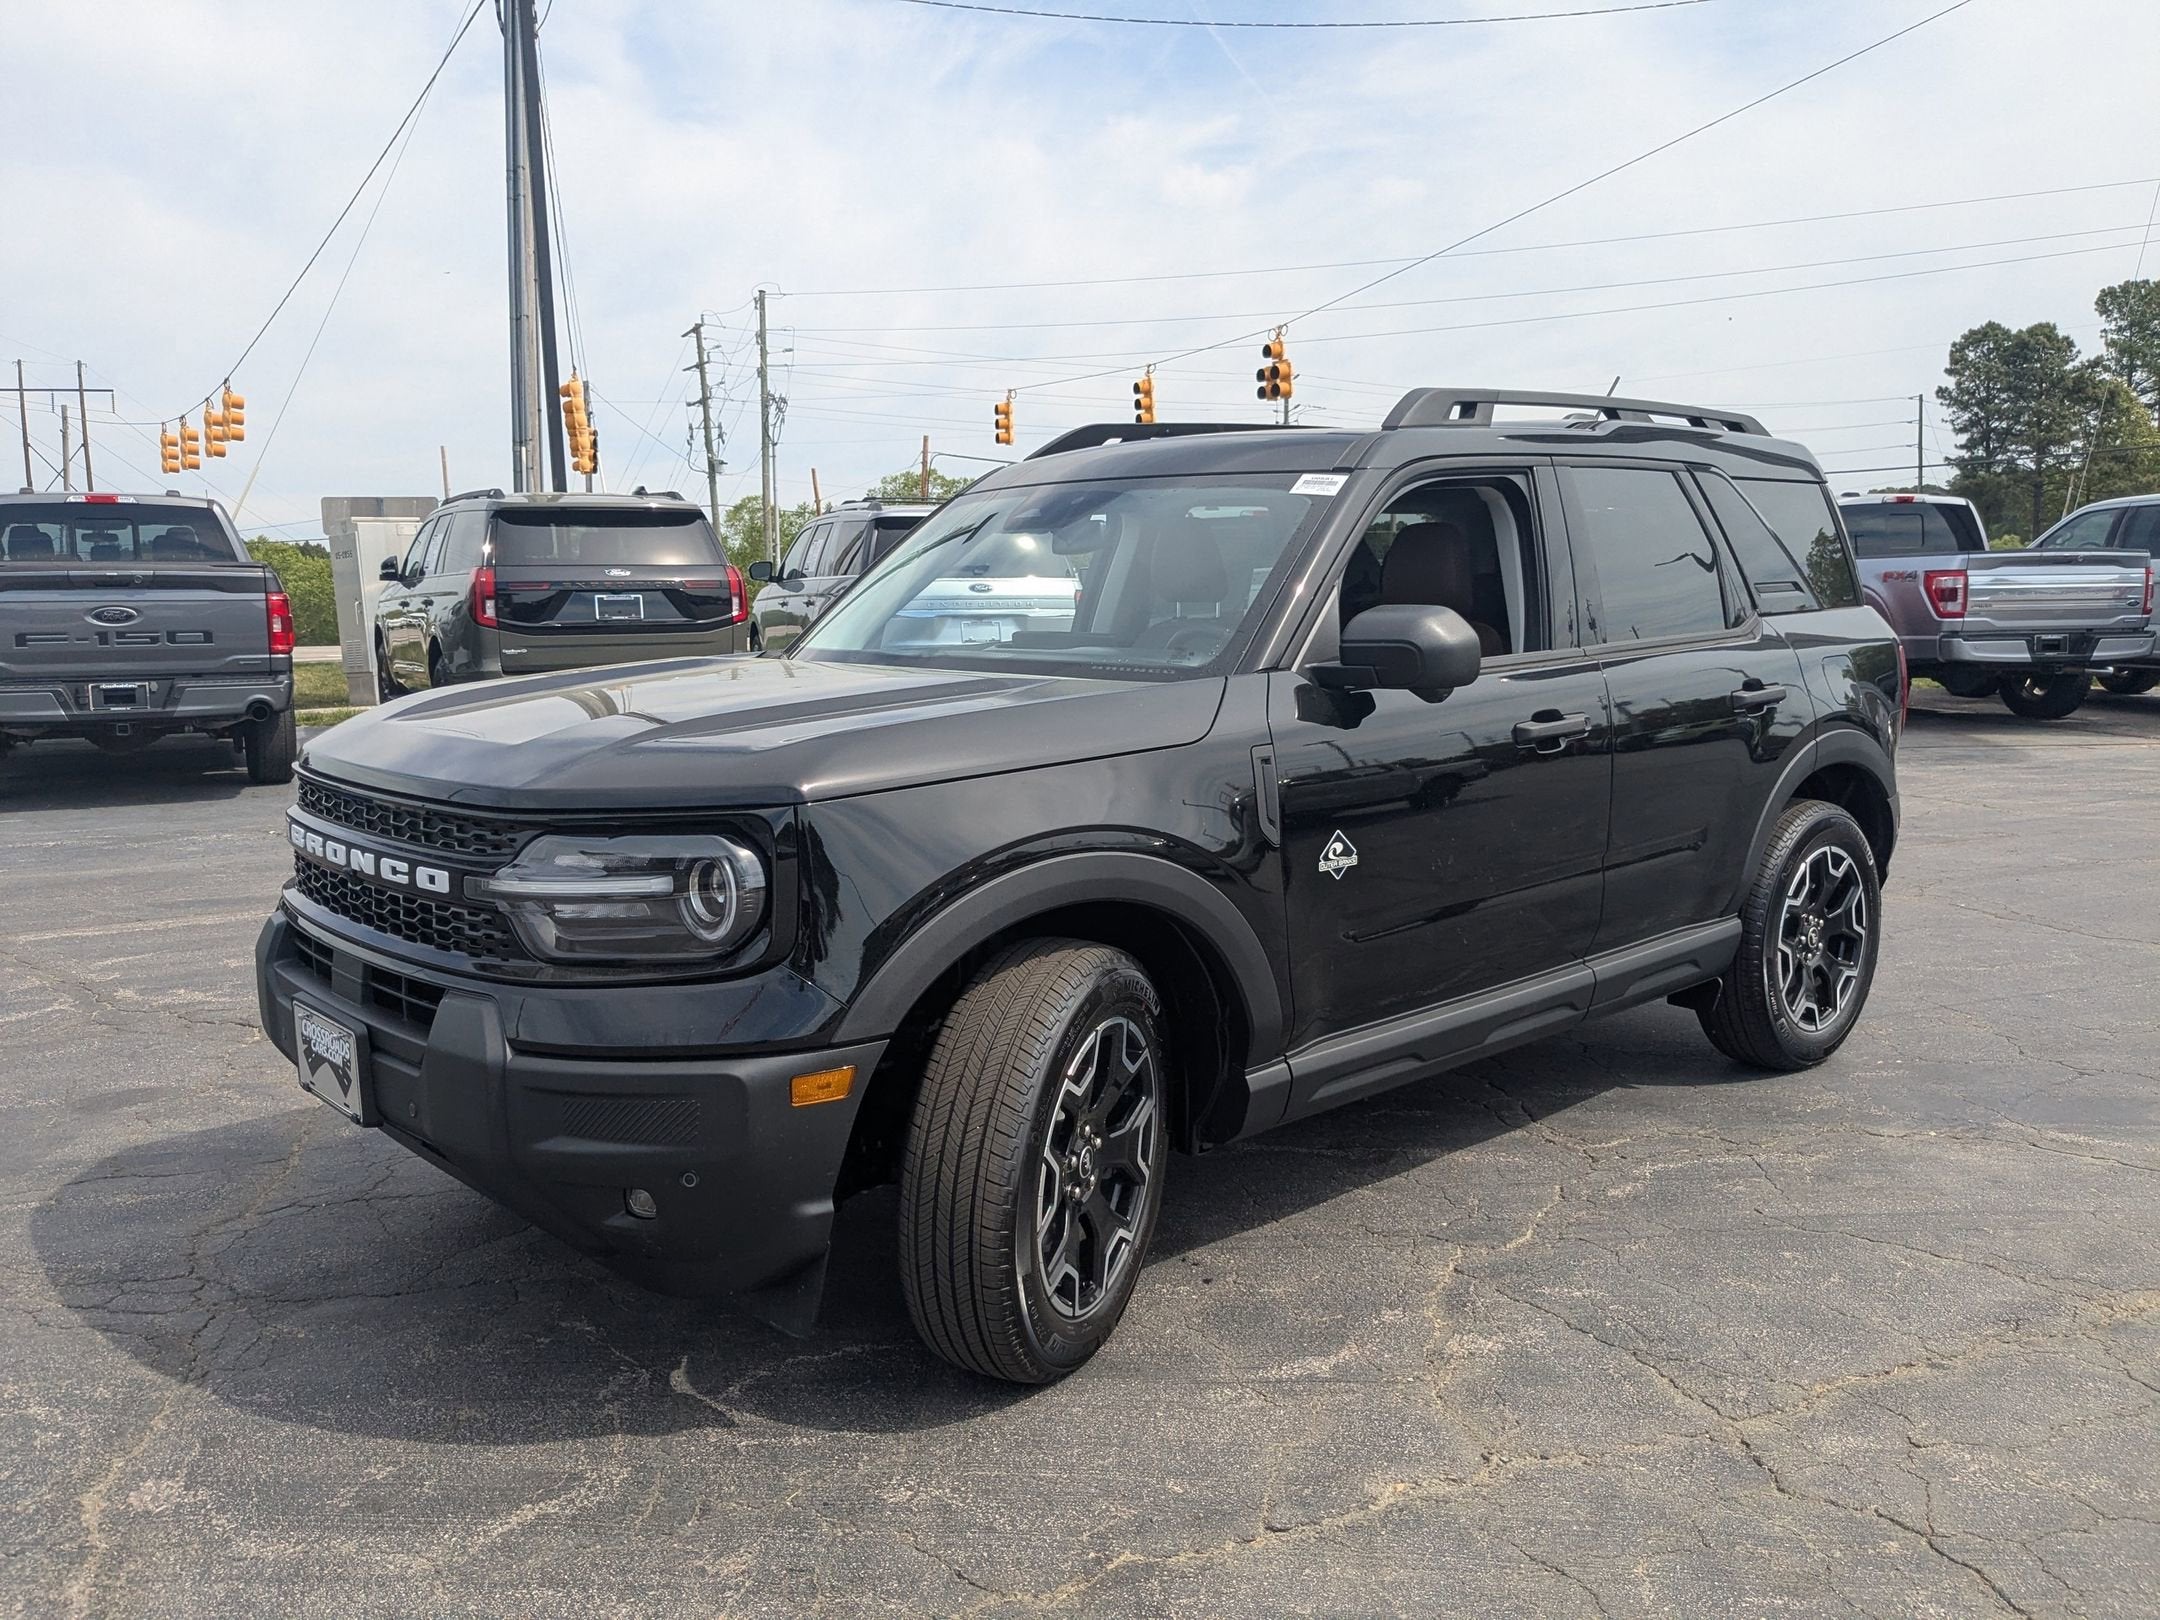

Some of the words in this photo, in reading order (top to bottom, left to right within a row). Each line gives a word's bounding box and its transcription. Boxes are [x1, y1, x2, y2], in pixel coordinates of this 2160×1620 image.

[1881, 571, 1918, 583] FX4
[13, 631, 215, 649] F-150
[290, 823, 450, 894] BRONCO
[1124, 976, 1160, 1013] MICHELIN
[302, 1018, 350, 1060] CROSSROADS
[311, 1039, 343, 1067] CARS.COM
